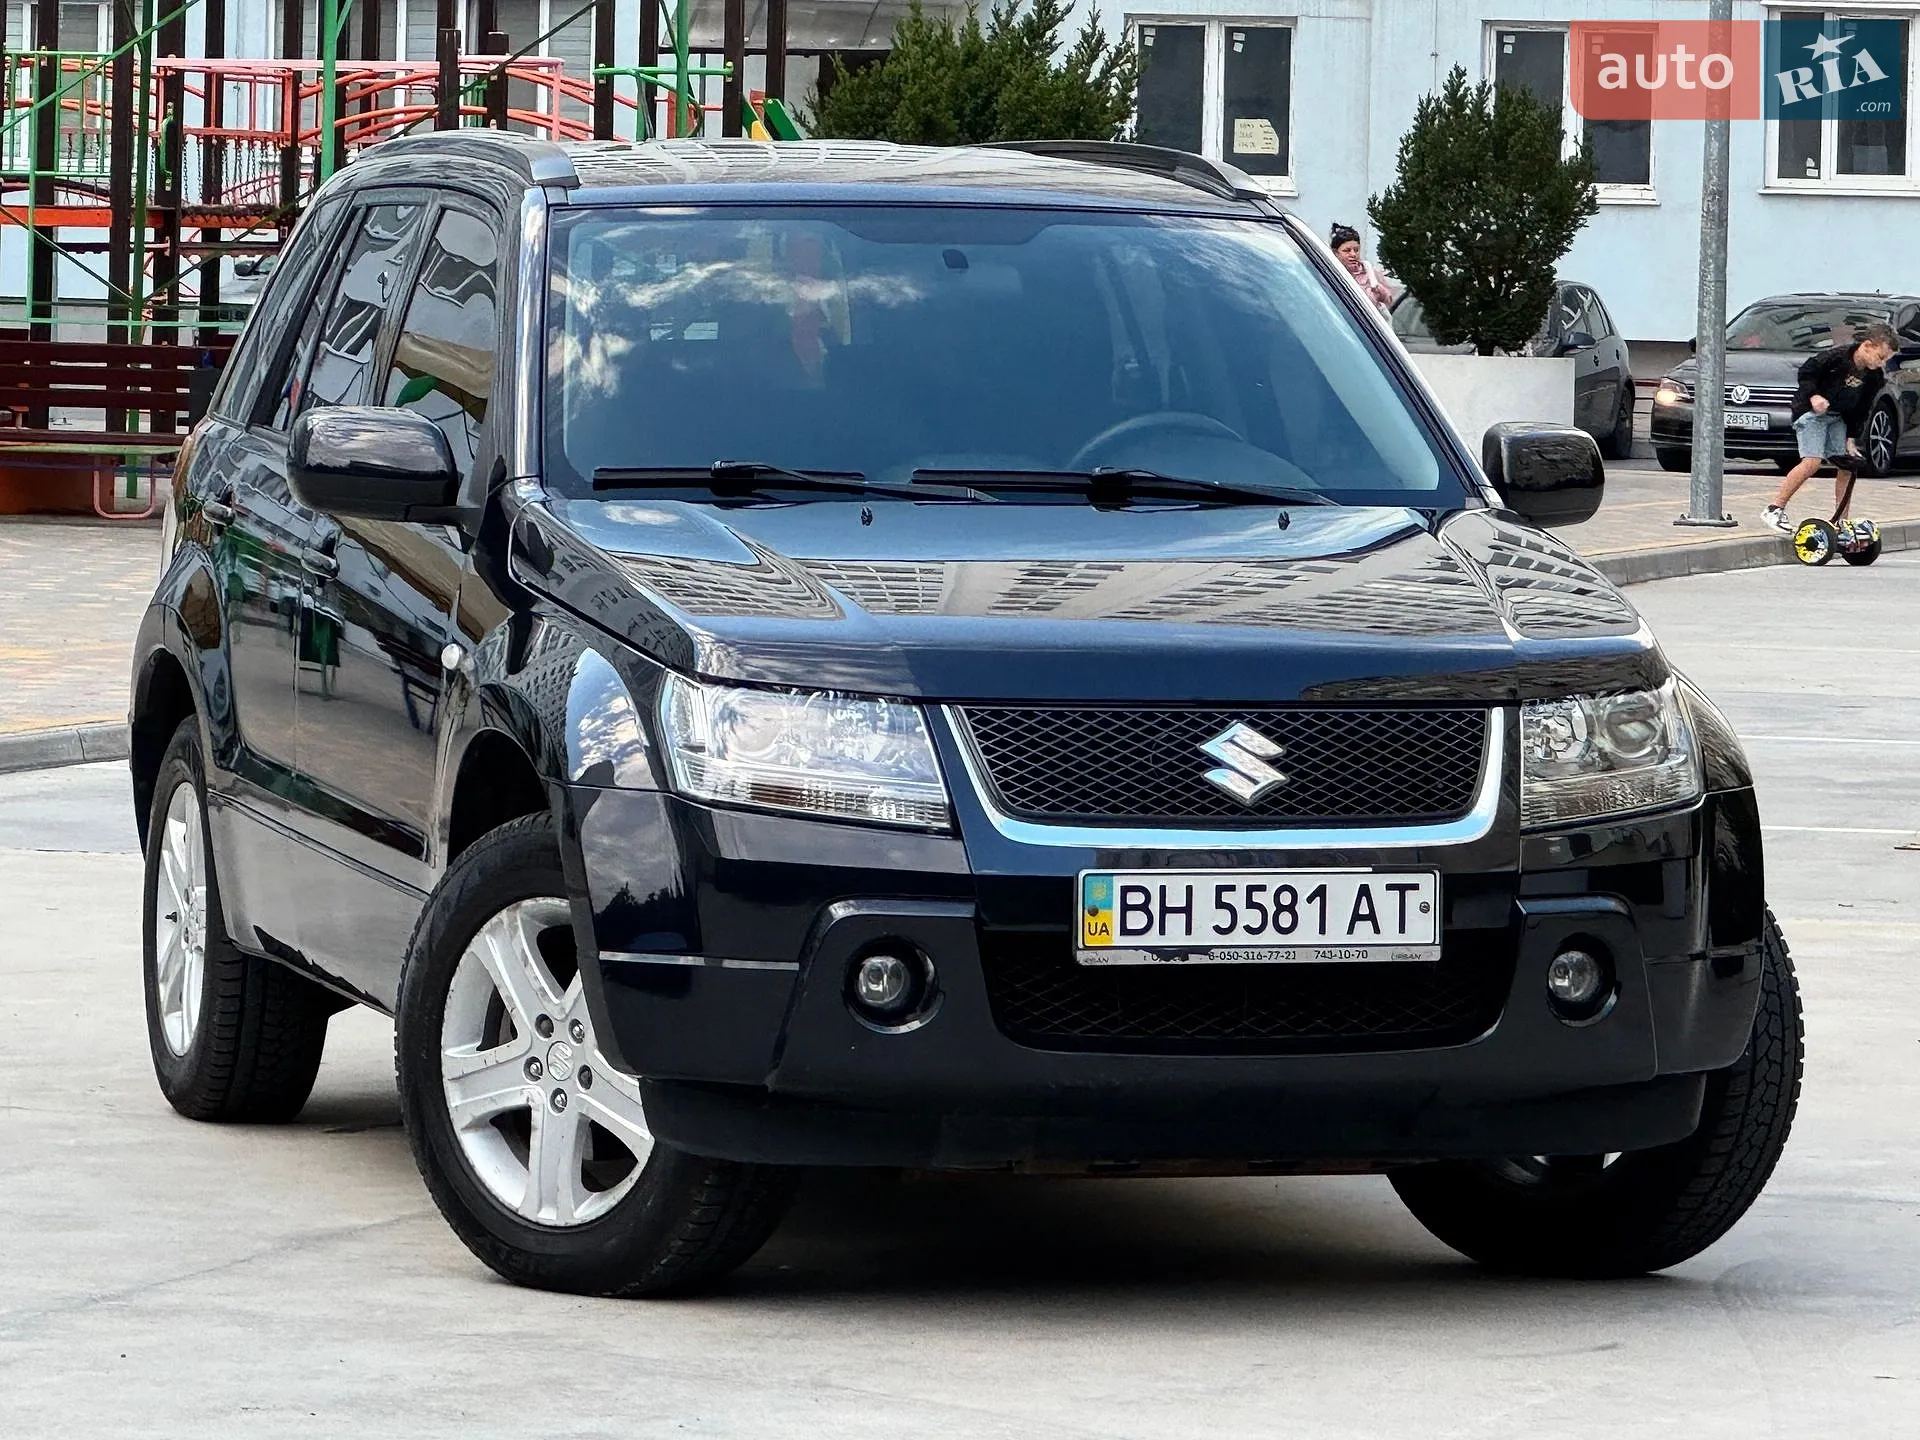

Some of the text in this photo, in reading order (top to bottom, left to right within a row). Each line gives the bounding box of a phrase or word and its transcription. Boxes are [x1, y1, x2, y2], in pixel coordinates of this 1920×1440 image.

[1119, 882, 1420, 937] BH 5581 AT
[1087, 921, 1110, 936] UA
